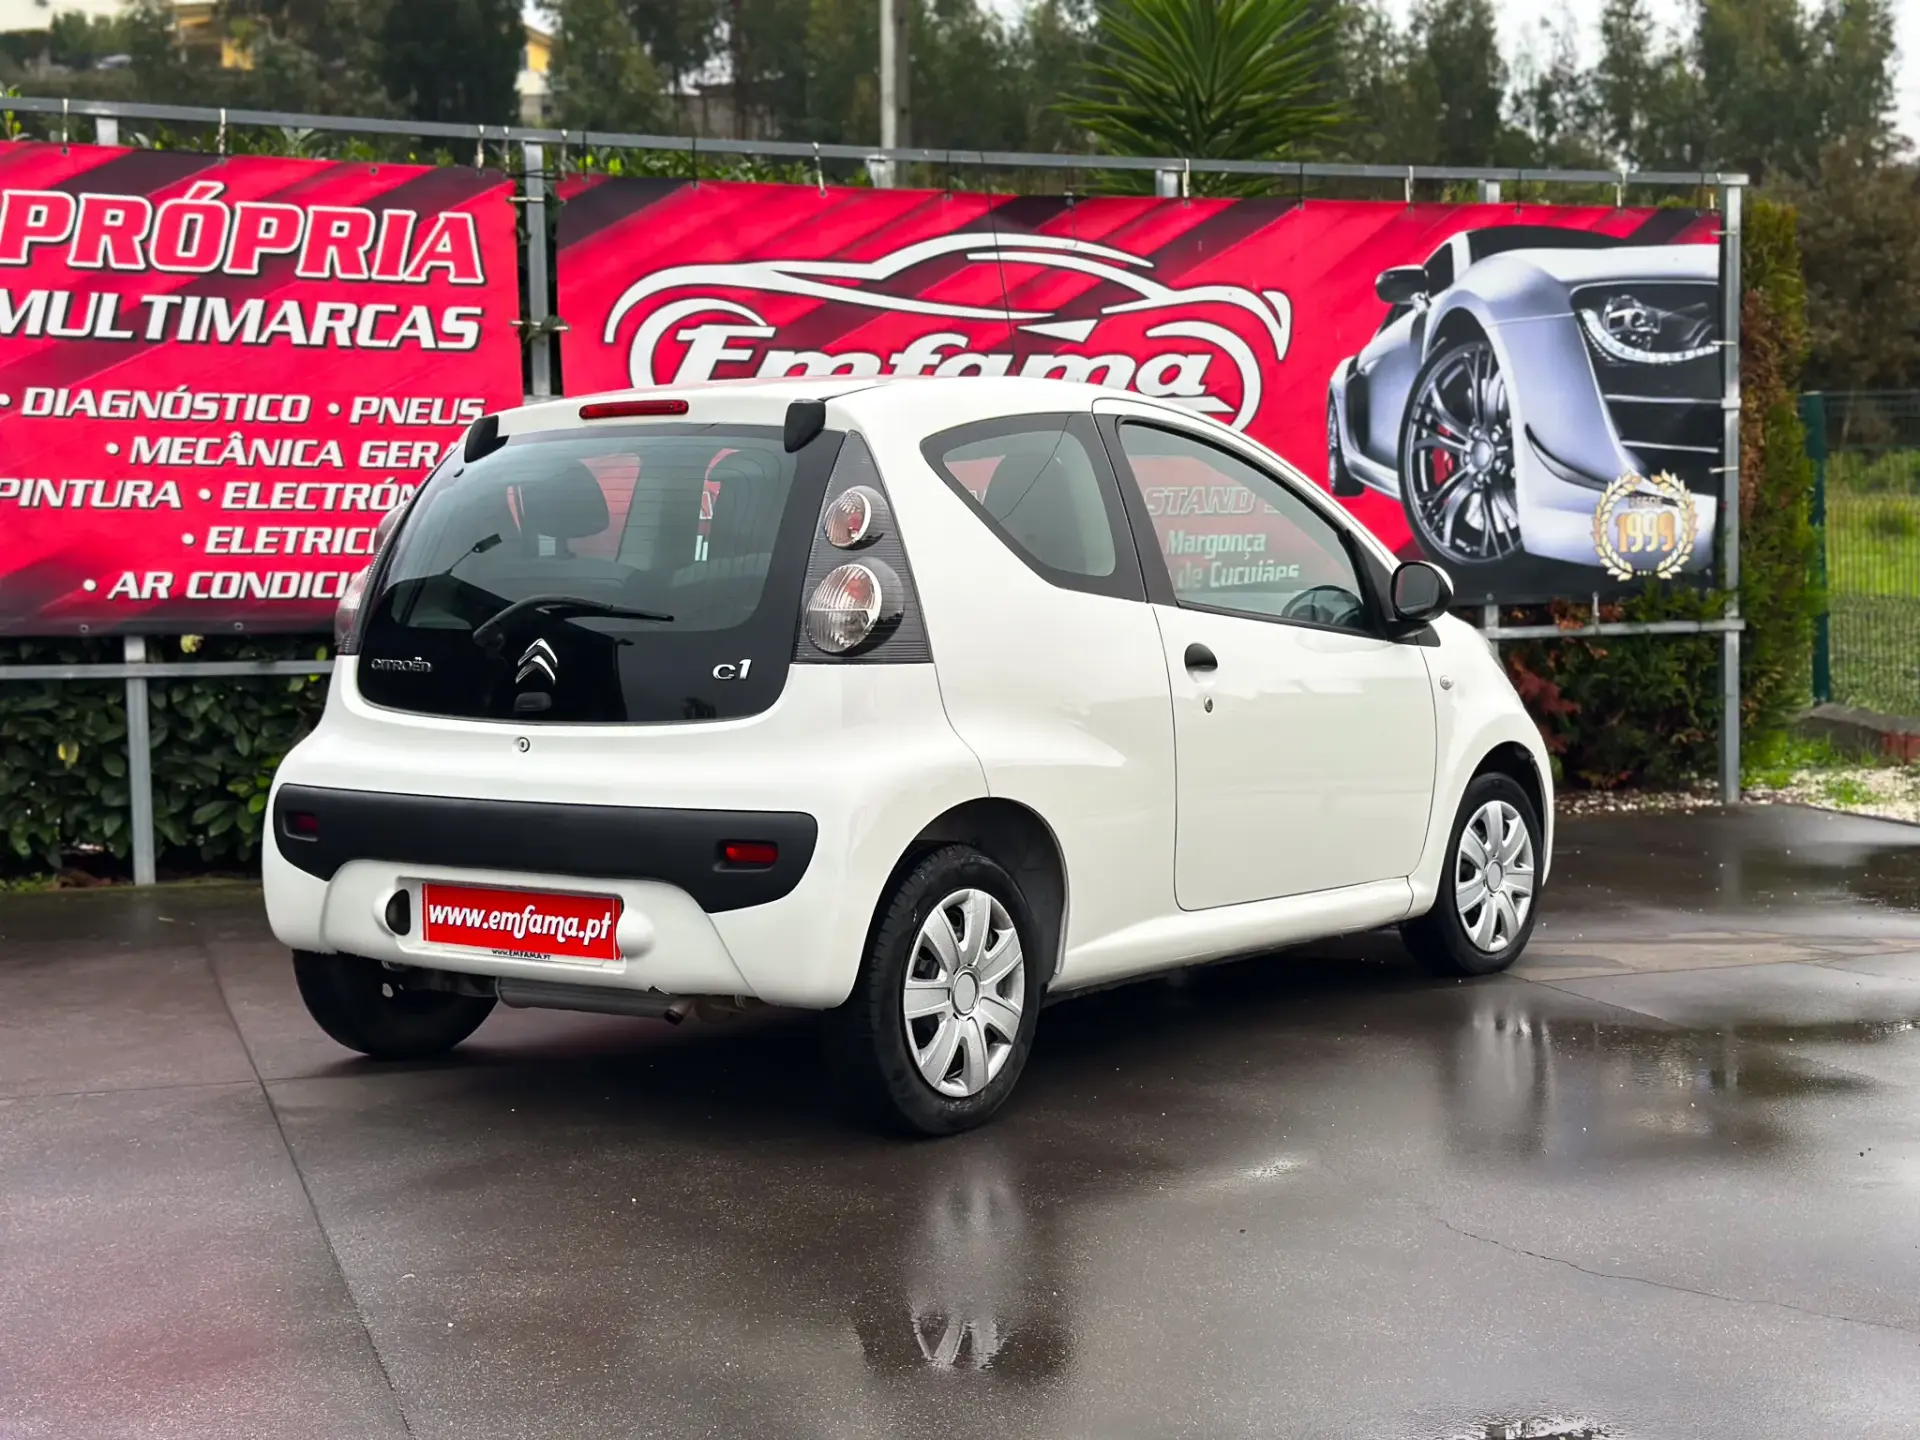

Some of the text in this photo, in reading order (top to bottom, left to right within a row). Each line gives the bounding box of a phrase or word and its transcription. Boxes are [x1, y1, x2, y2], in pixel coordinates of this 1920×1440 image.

[0, 180, 485, 284] PRÓPRIA
[0, 288, 483, 350] MULTIMARCAS
[21, 384, 485, 425] DIAGNÓSTICO PNEUS
[130, 431, 455, 468] MECÂNICA GER
[1144, 486, 1256, 515] STAND
[1166, 530, 1266, 559] Margonça
[1615, 511, 1675, 553] 1999
[107, 571, 174, 600] AR
[429, 904, 611, 946] www.emfama.pt
